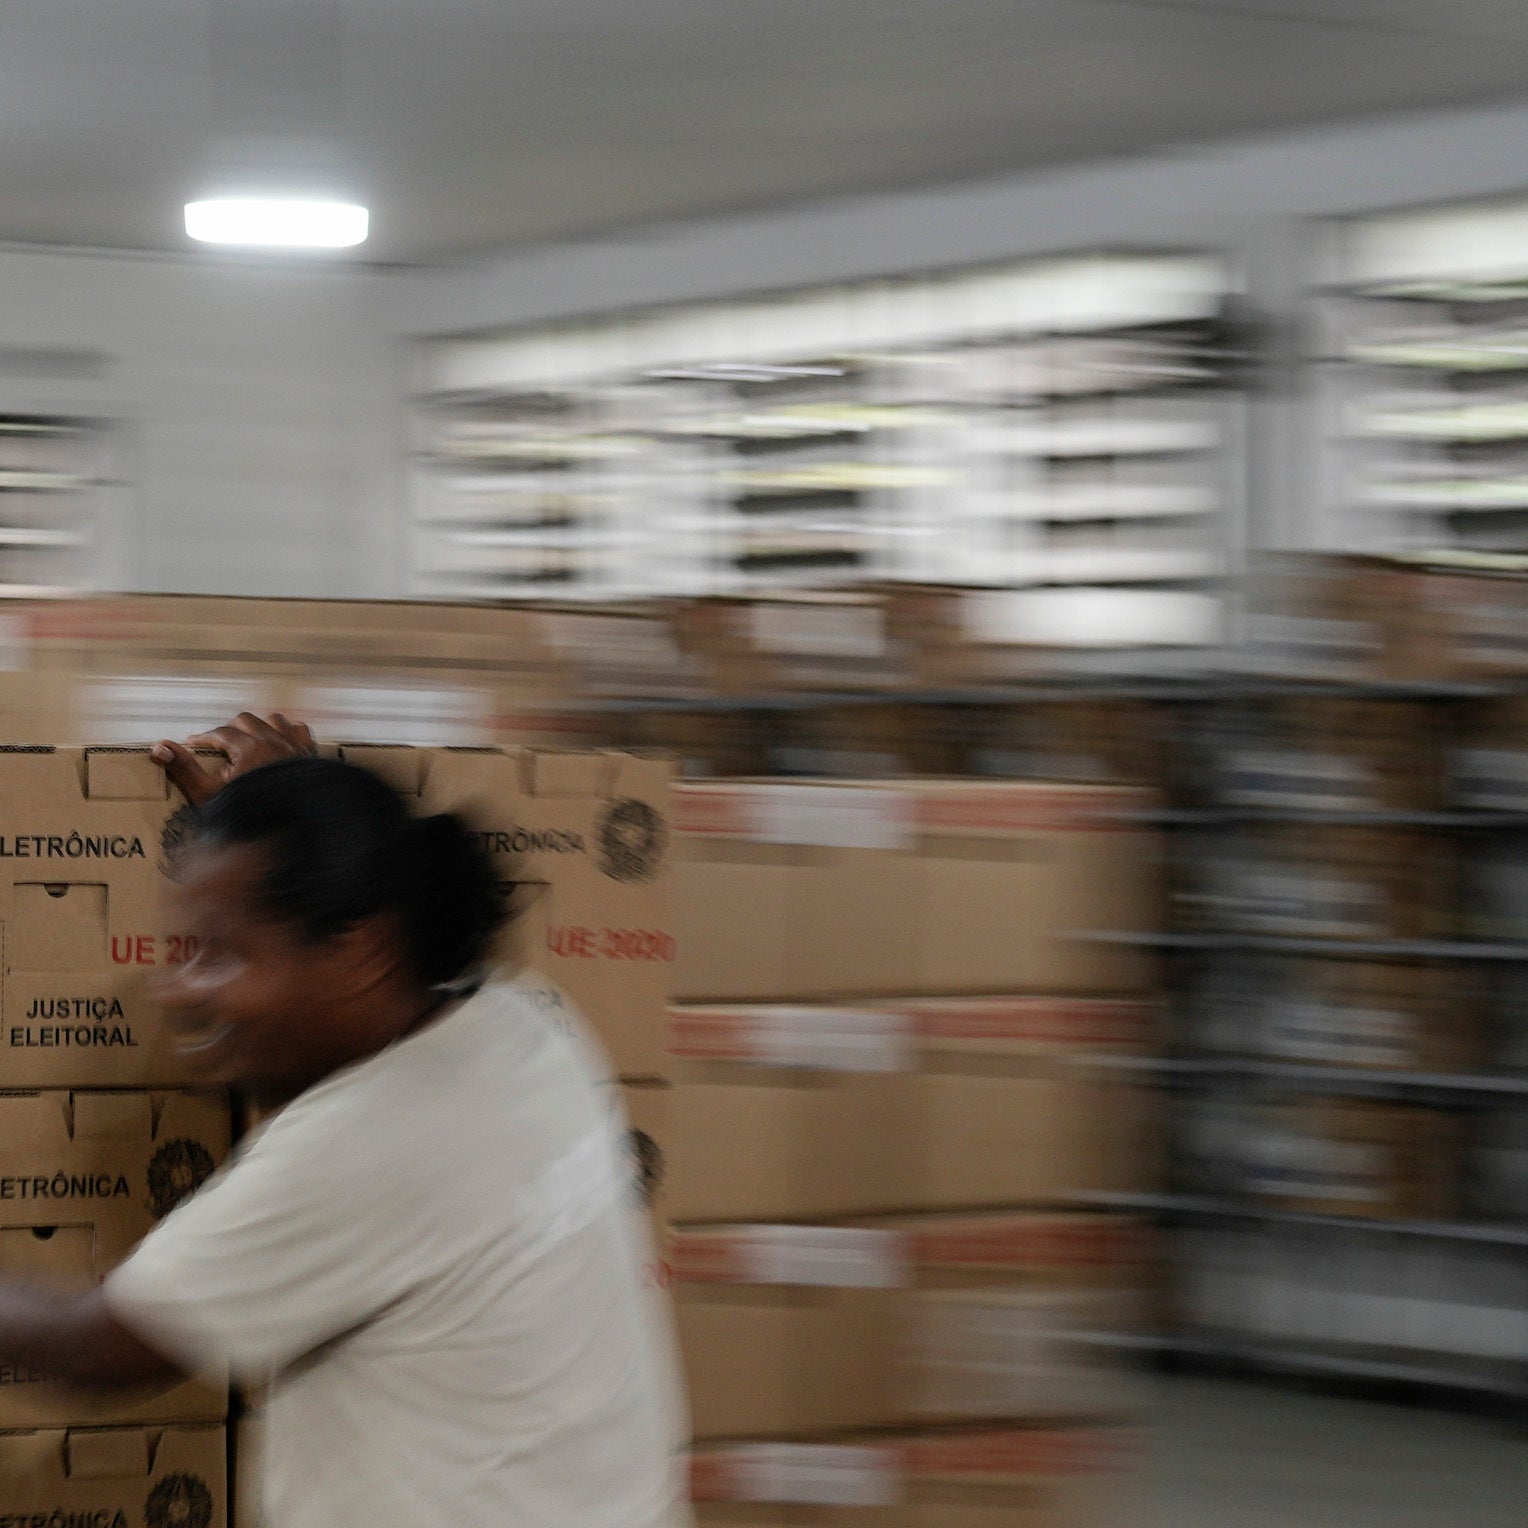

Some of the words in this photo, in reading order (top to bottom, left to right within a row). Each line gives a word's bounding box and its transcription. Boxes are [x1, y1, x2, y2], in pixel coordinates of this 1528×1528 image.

[111, 934, 156, 966] UE
[26, 997, 125, 1023] JUSTIÇA
[10, 1024, 138, 1047] ELEITORAL
